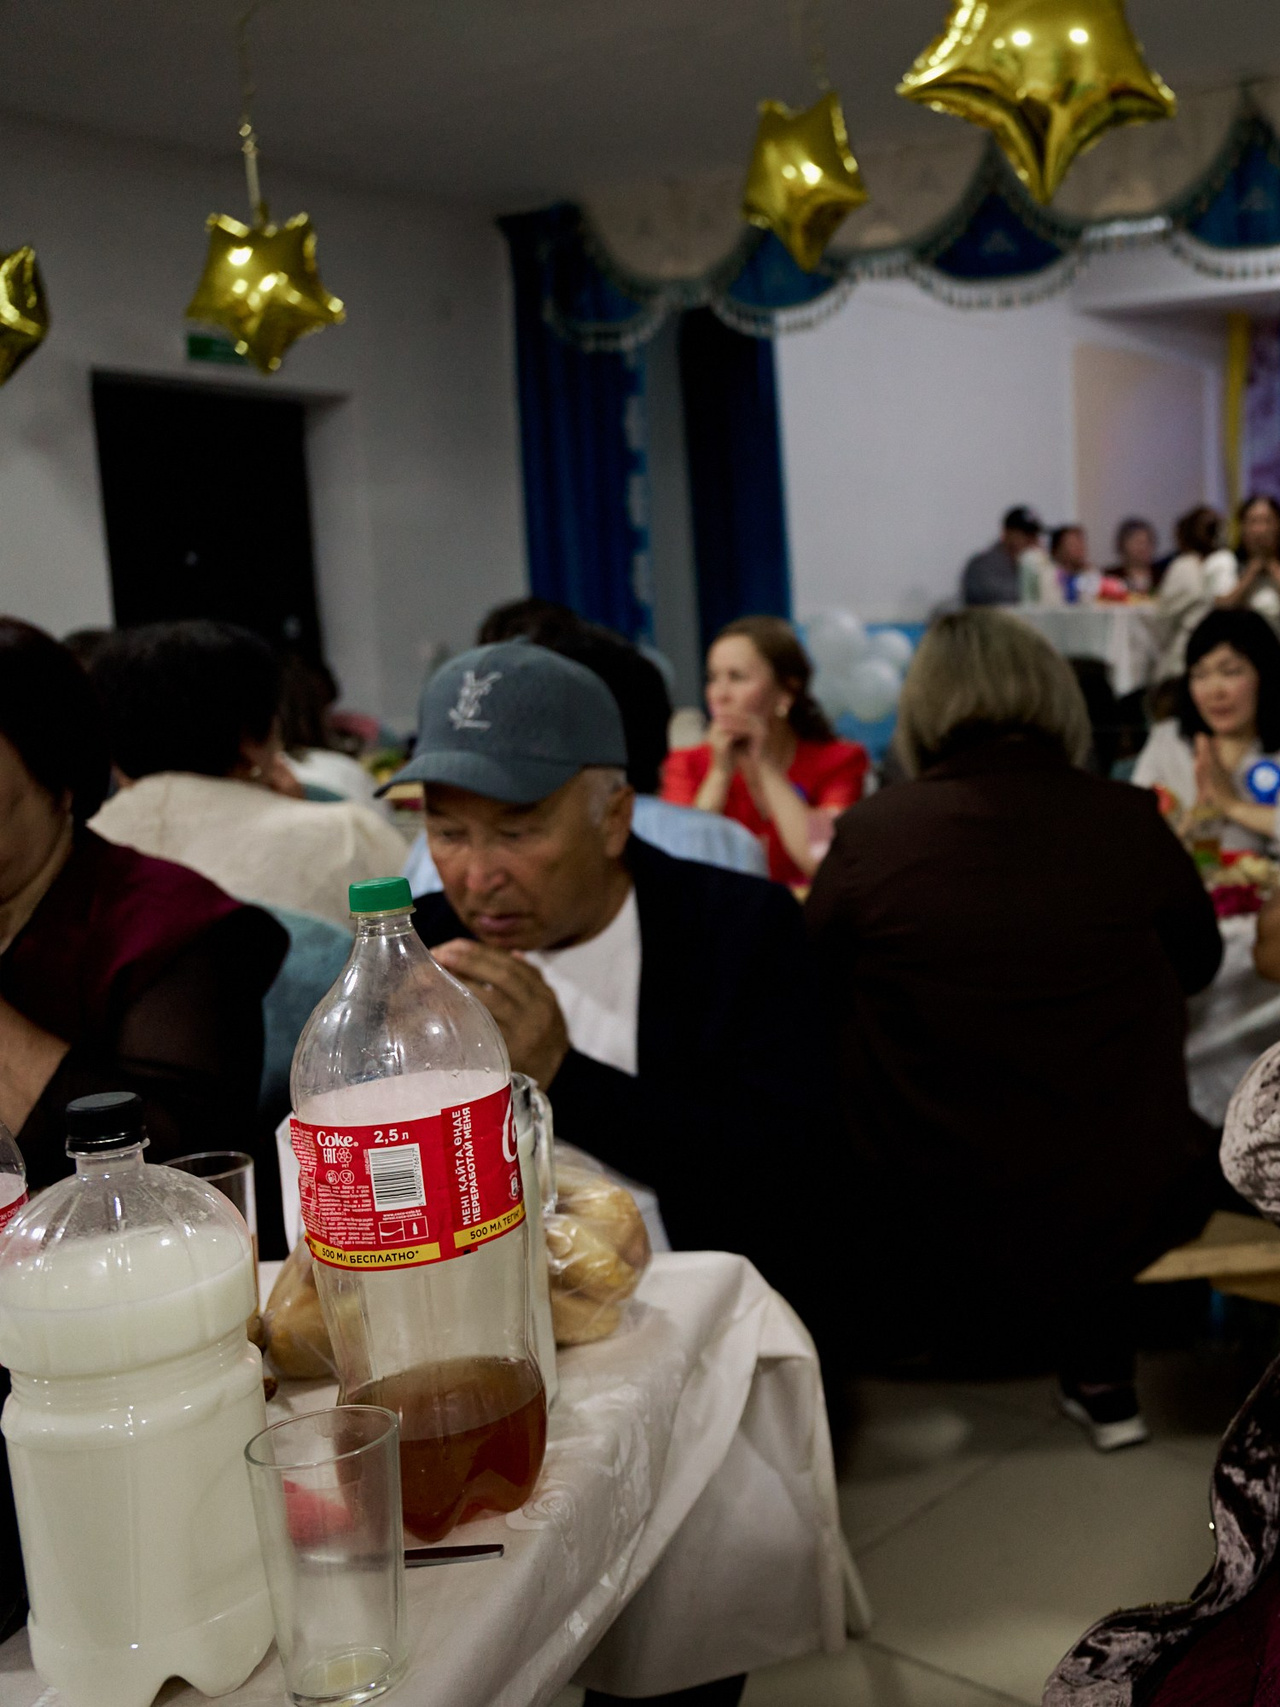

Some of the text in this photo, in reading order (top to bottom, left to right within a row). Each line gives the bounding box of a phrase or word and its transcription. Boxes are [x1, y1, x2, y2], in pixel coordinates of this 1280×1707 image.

[317, 1130, 354, 1147] Coke
[373, 1129, 409, 1144] 2,5 л
[463, 1107, 481, 1222] ПЕРЕРАБОТАЙ МЕНЯ
[462, 1196, 472, 1225] МЕНІ
[470, 1226, 488, 1240] 500
[490, 1221, 502, 1233] МЛ
[322, 1247, 335, 1259] 500
[337, 1252, 348, 1263] МЛ
